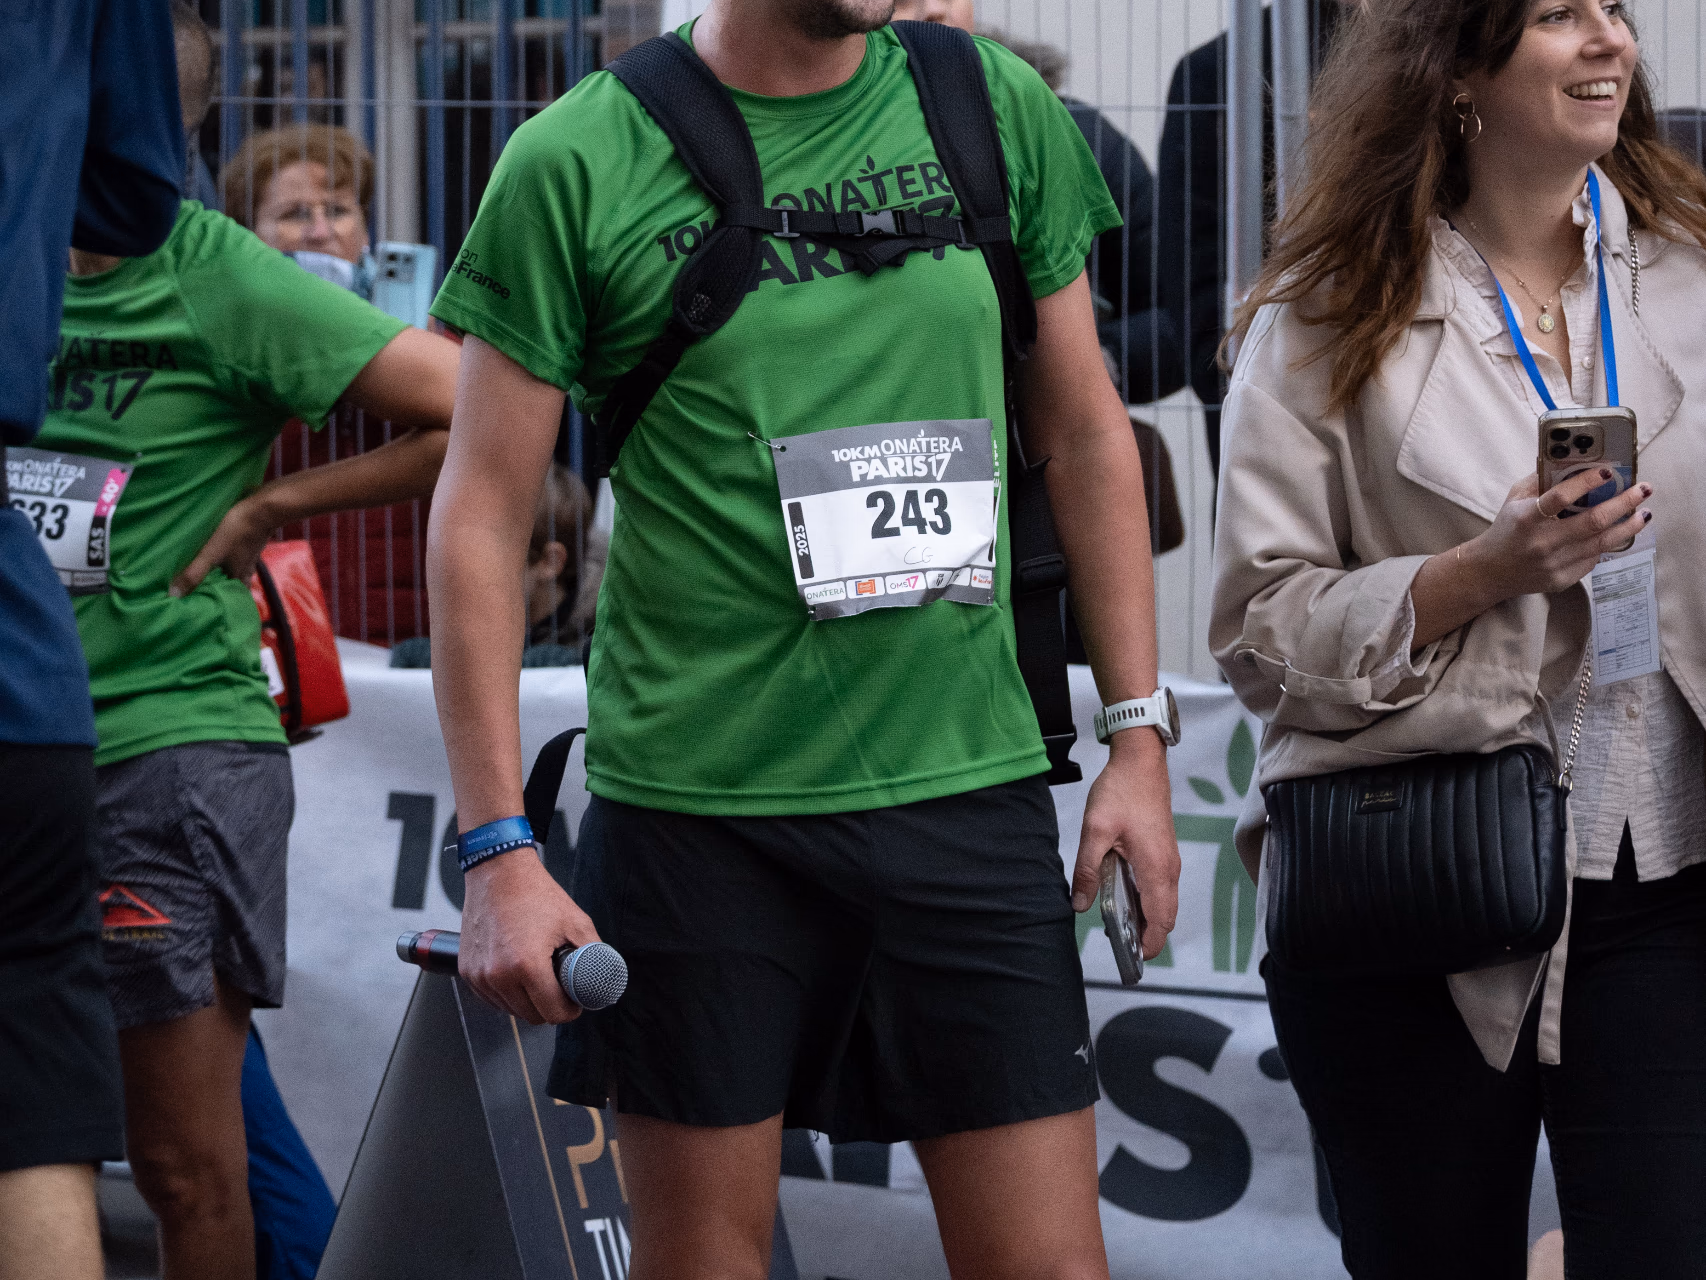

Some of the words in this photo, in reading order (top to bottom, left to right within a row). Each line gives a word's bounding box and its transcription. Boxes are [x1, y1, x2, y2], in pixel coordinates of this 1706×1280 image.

[771, 160, 952, 214] ONATER
[60, 337, 178, 371] ATERA
[866, 488, 952, 539] 243
[795, 524, 809, 557] 2025
[806, 586, 845, 600] ONATERA
